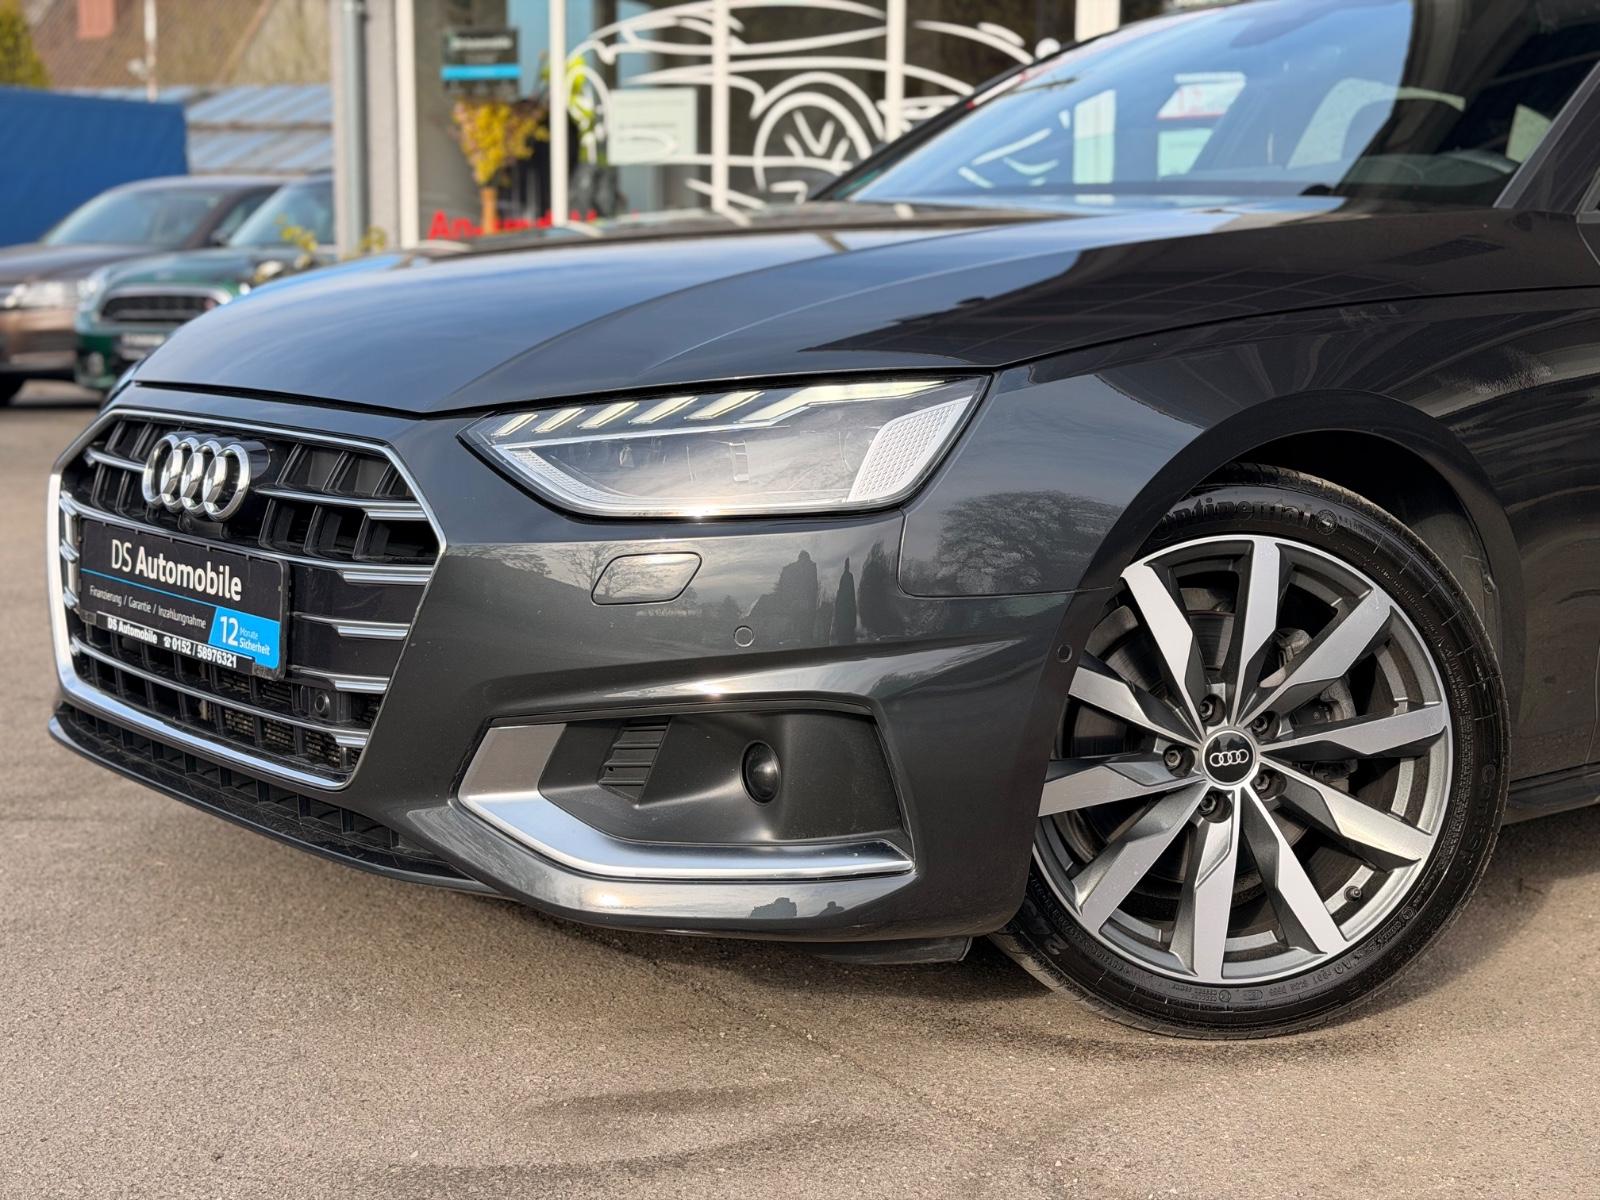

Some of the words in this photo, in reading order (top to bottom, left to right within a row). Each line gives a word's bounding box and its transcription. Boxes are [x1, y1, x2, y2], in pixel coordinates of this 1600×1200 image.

[1160, 496, 1313, 530] ontinental
[111, 538, 133, 573] DS
[134, 546, 243, 602] Automobile
[89, 585, 123, 607] Finanzierung
[128, 596, 152, 613] Garantie
[158, 605, 207, 630] Inzahlungnahme
[107, 616, 118, 631] DS
[118, 620, 158, 644] Automobile
[220, 615, 239, 646] 12
[240, 627, 259, 640] Monate
[171, 640, 192, 656] 0152
[197, 644, 238, 669] 58976321
[239, 638, 271, 656] Sicherheit
